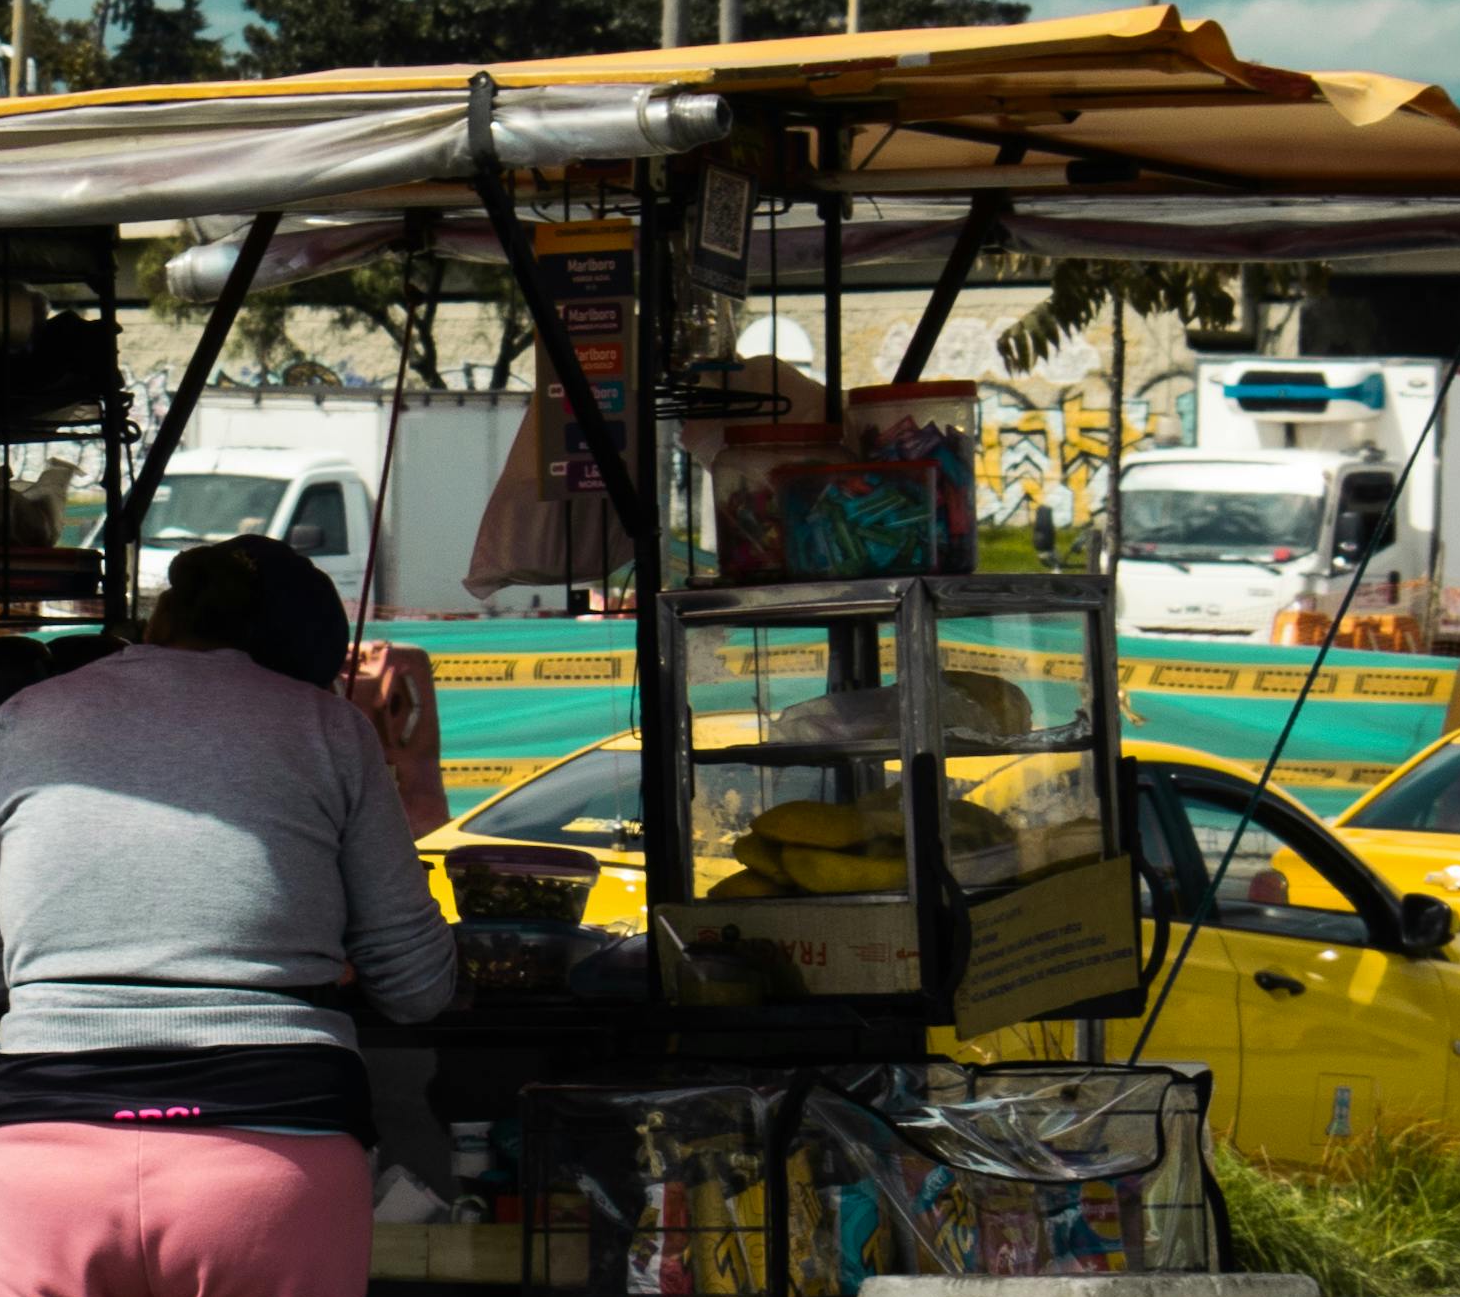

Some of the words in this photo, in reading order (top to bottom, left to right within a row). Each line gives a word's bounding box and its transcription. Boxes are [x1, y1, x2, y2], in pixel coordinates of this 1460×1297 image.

[566, 258, 615, 273] Marlboro
[568, 309, 616, 322] Marlboro
[575, 348, 616, 362] arlboro
[590, 387, 618, 399] lboro
